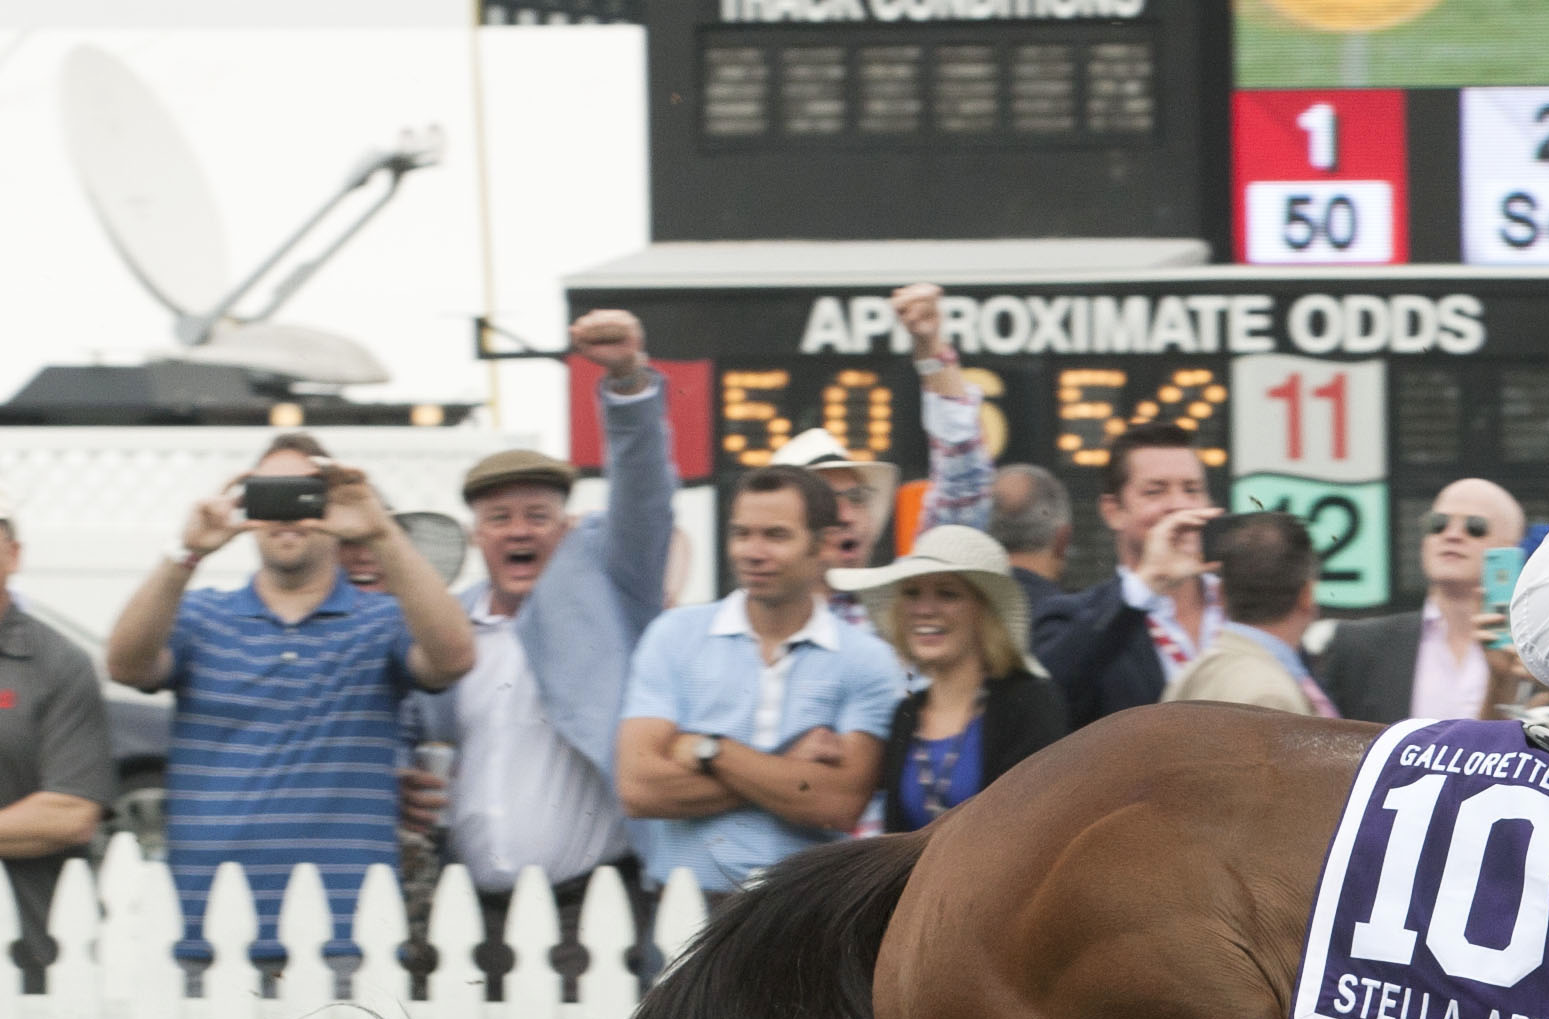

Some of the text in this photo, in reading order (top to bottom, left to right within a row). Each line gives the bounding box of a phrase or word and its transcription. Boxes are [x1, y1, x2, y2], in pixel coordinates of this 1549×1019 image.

[1299, 103, 1337, 170] 1
[1283, 195, 1358, 251] 50
[1288, 295, 1486, 355] ODDS
[721, 367, 893, 467] 50
[1265, 372, 1349, 462] 11
[1268, 494, 1363, 583] 2
